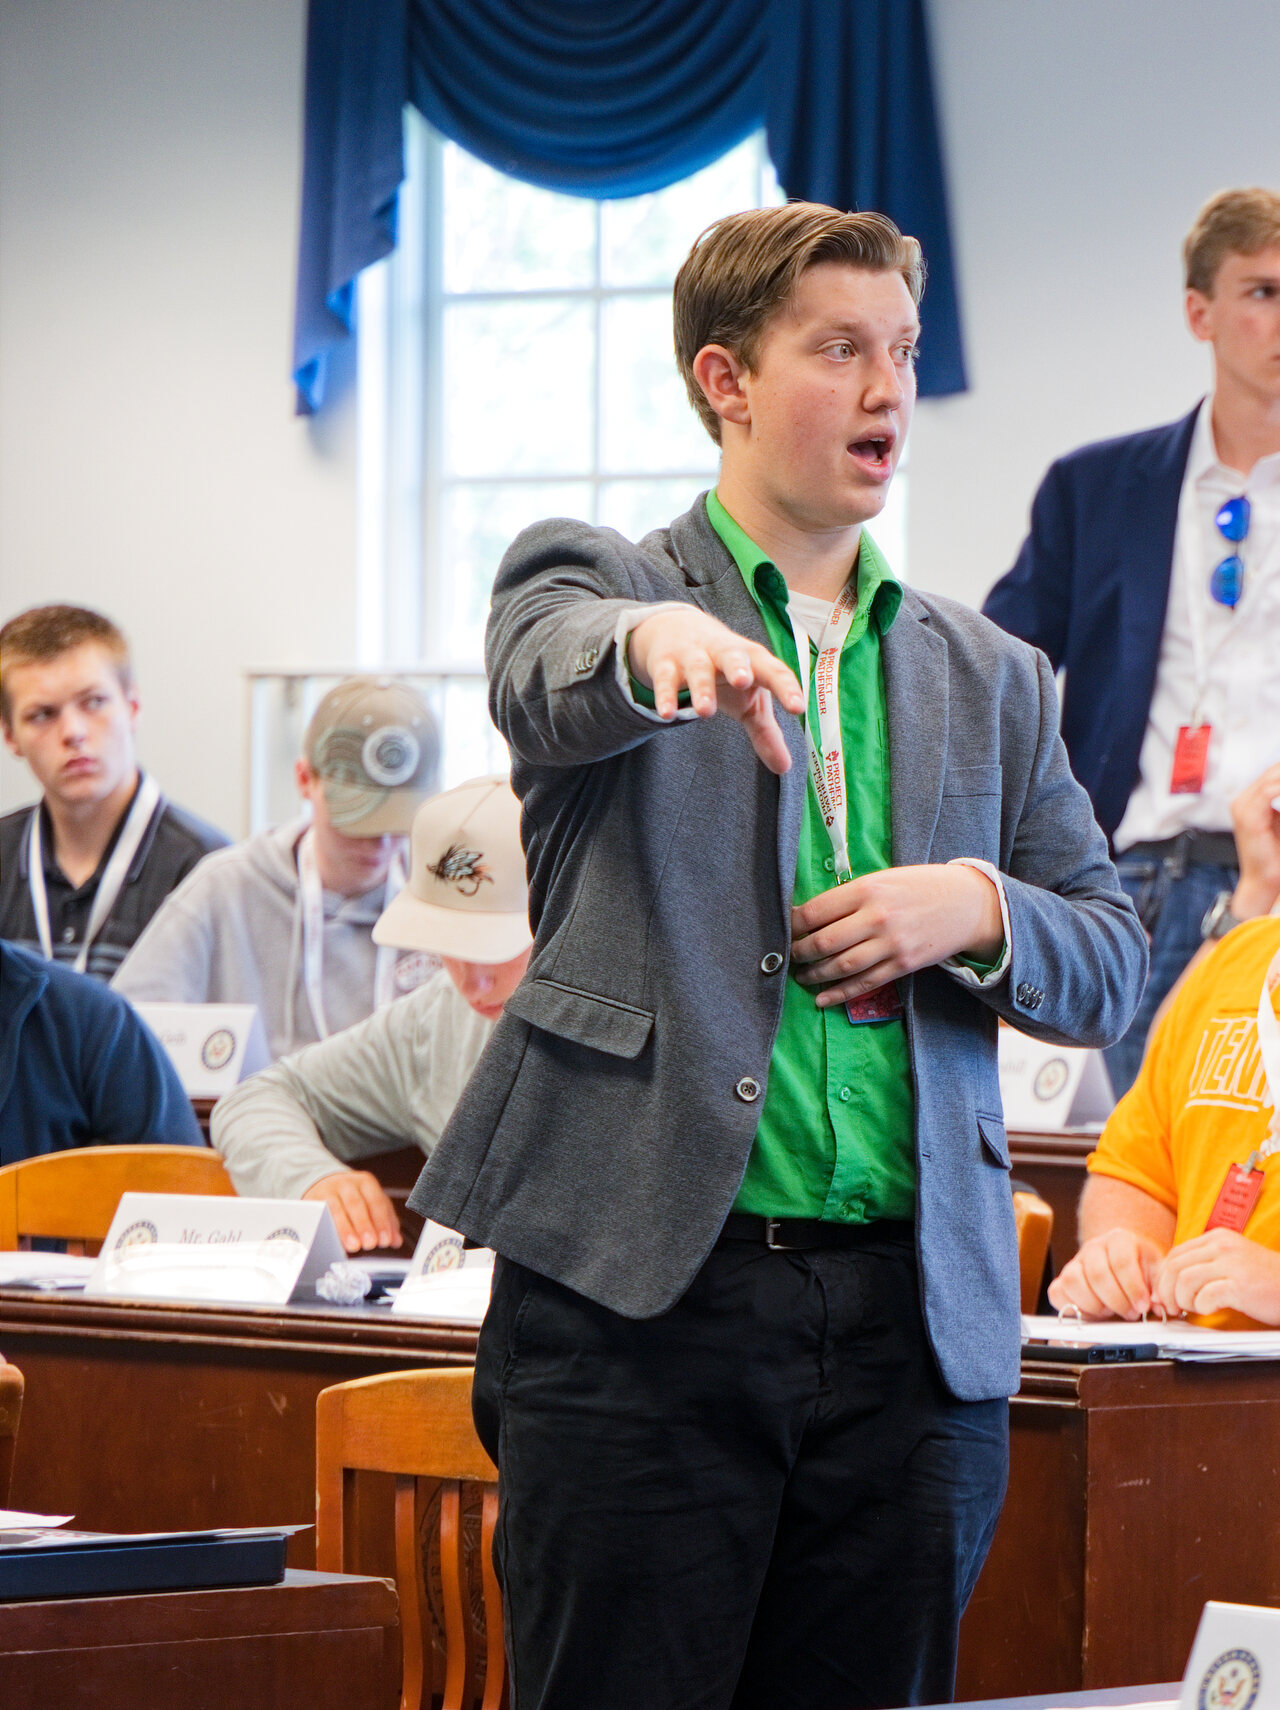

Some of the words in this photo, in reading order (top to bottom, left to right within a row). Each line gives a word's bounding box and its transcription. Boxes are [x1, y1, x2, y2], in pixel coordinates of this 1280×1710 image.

[817, 657, 827, 715] PATHFINDER
[825, 655, 836, 695] PROJECT
[833, 762, 843, 807] PROJECT
